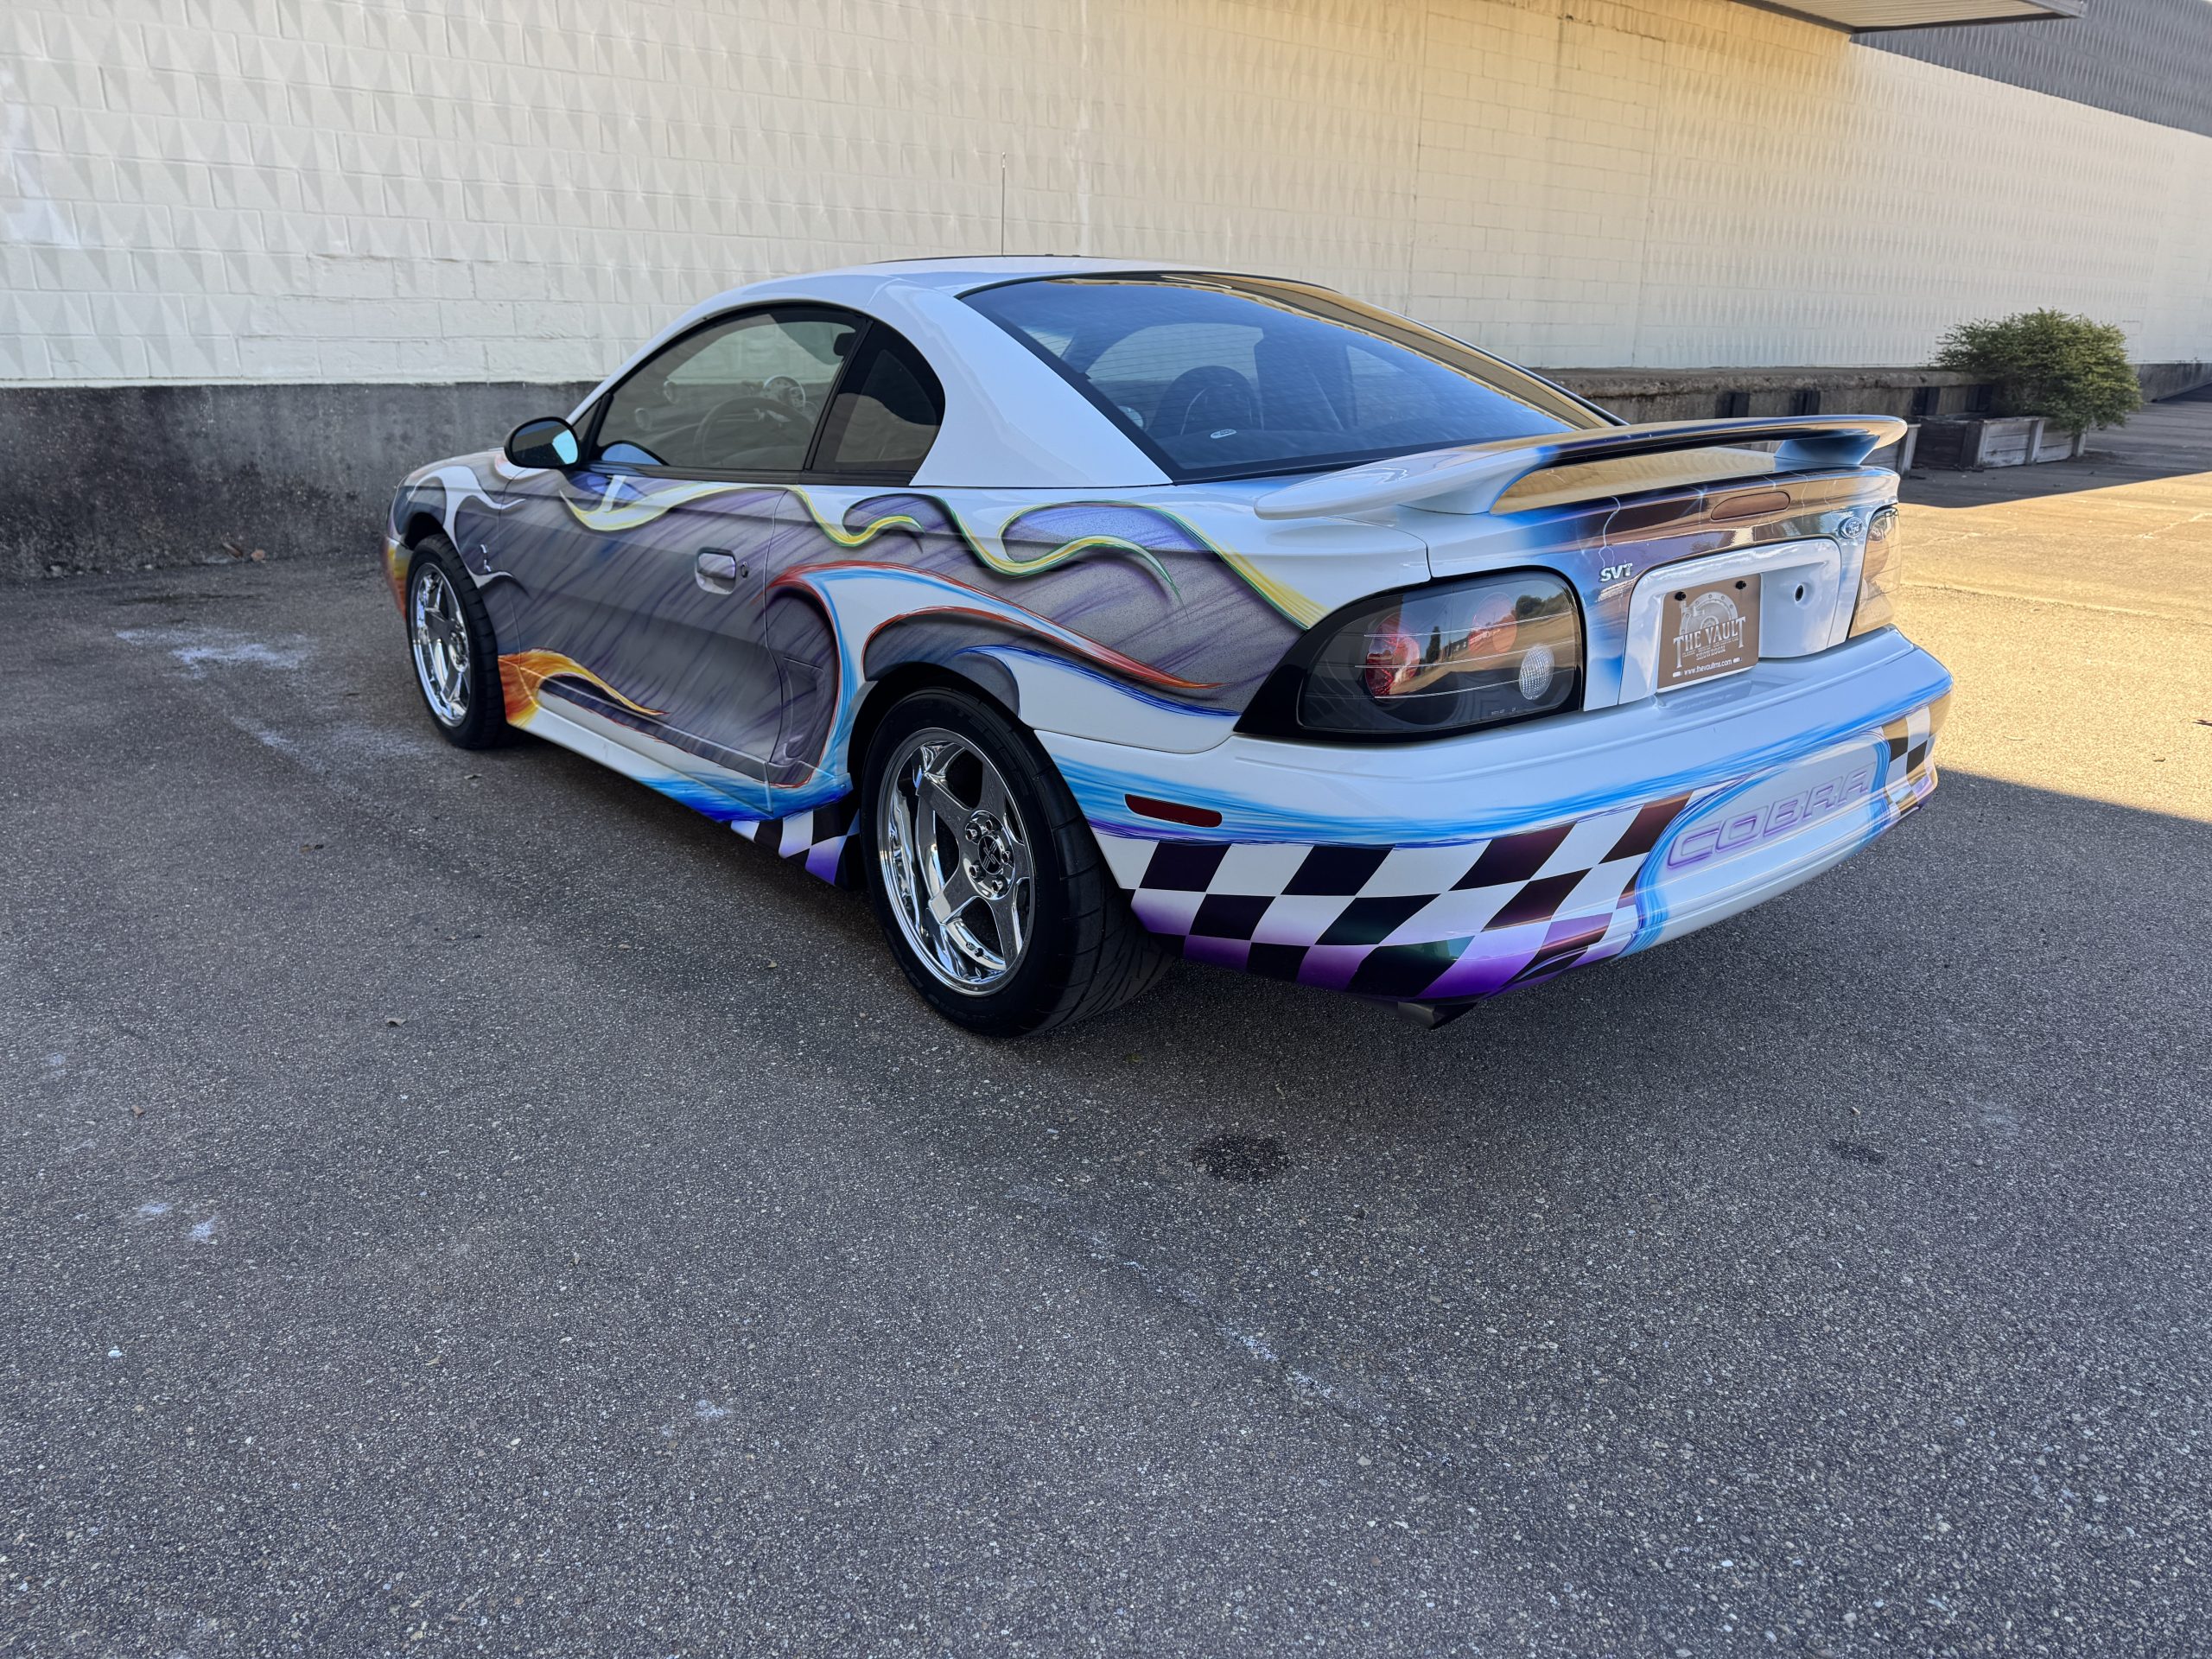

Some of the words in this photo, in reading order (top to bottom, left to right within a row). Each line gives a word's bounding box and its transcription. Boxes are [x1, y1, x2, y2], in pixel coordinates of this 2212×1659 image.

[1599, 563, 1633, 582] SVT
[1673, 630, 1701, 669] THE
[1705, 616, 1746, 649] VAULT
[1695, 645, 1726, 661] SHOWROOM
[1667, 762, 1877, 869] COBRA
